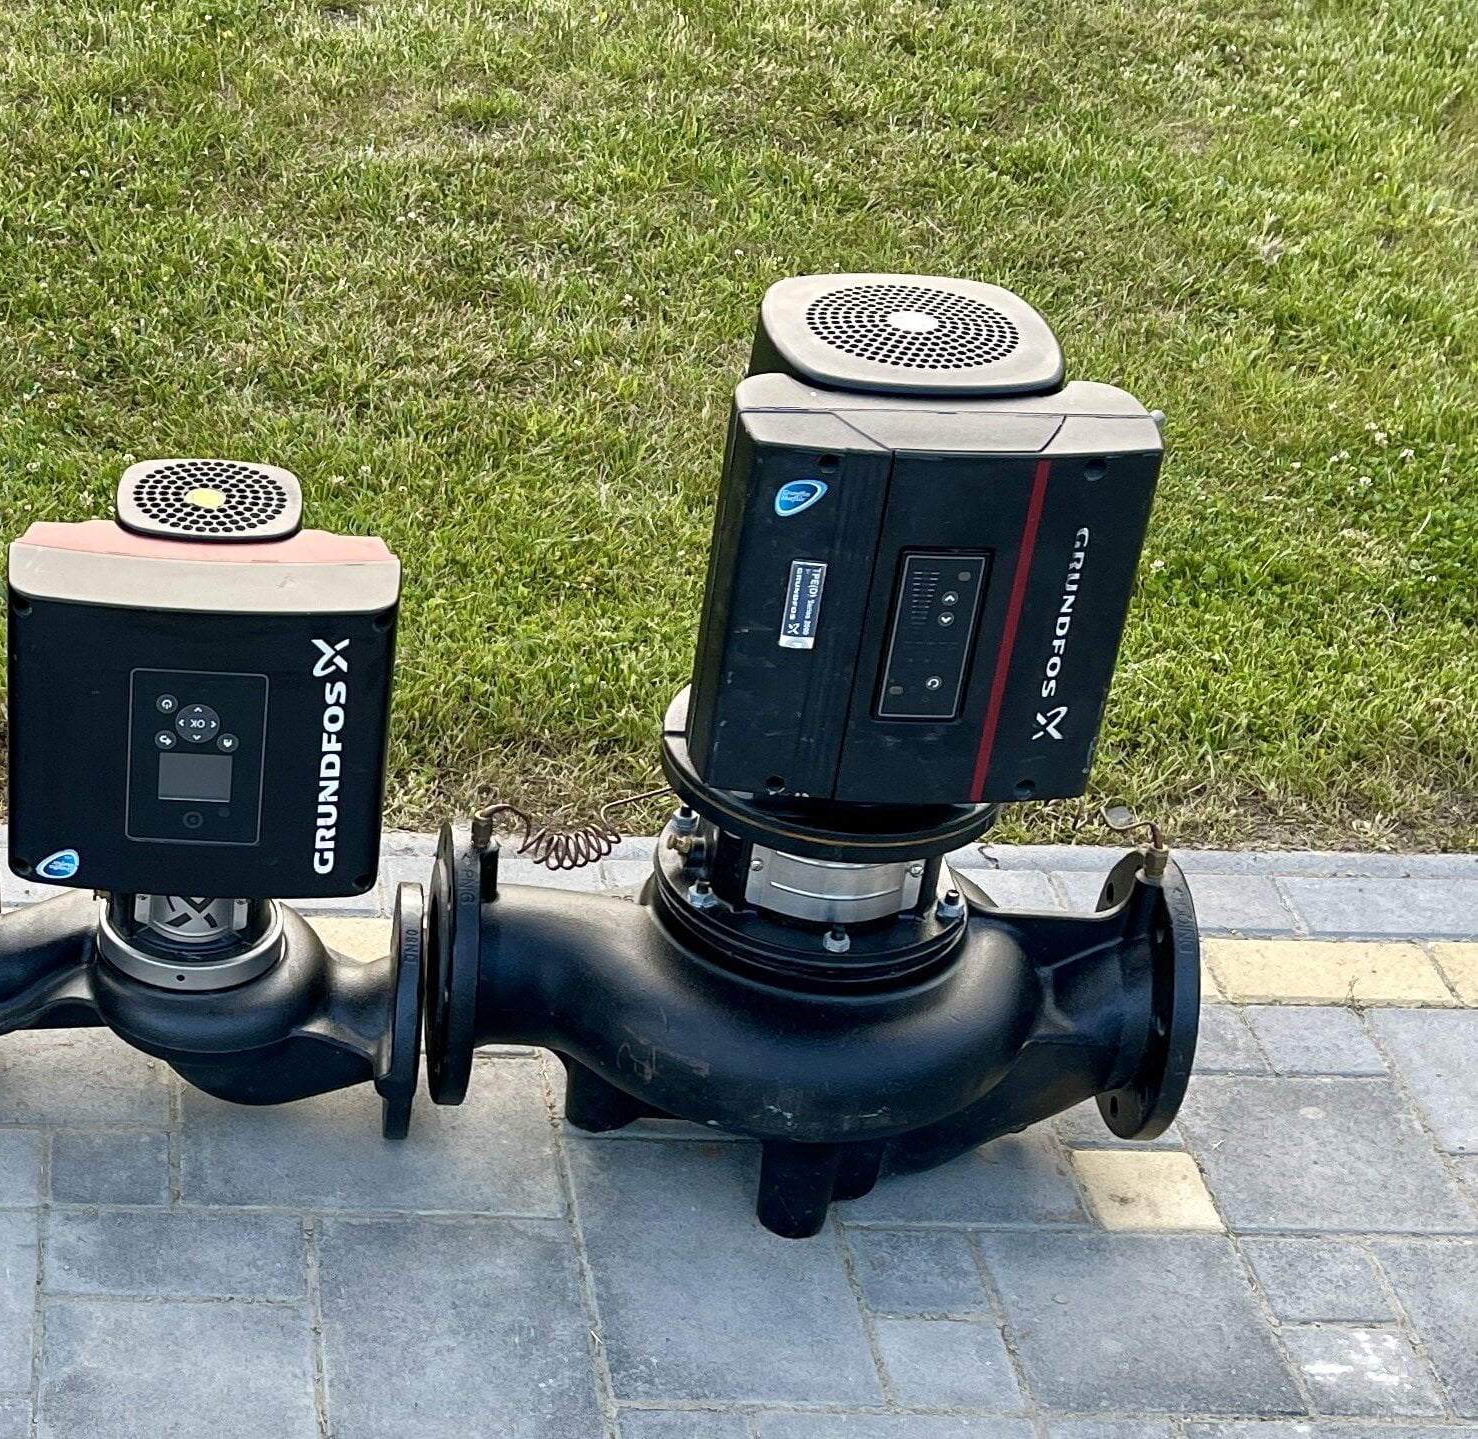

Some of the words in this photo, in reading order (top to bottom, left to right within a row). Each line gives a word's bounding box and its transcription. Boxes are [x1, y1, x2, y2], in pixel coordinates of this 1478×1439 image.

[789, 567, 803, 620] GRUNDFOS
[1041, 526, 1090, 698] GRUNDFOS
[190, 718, 206, 729] OK
[313, 681, 347, 874] GRUNDFOS
[403, 929, 419, 962] DN80
